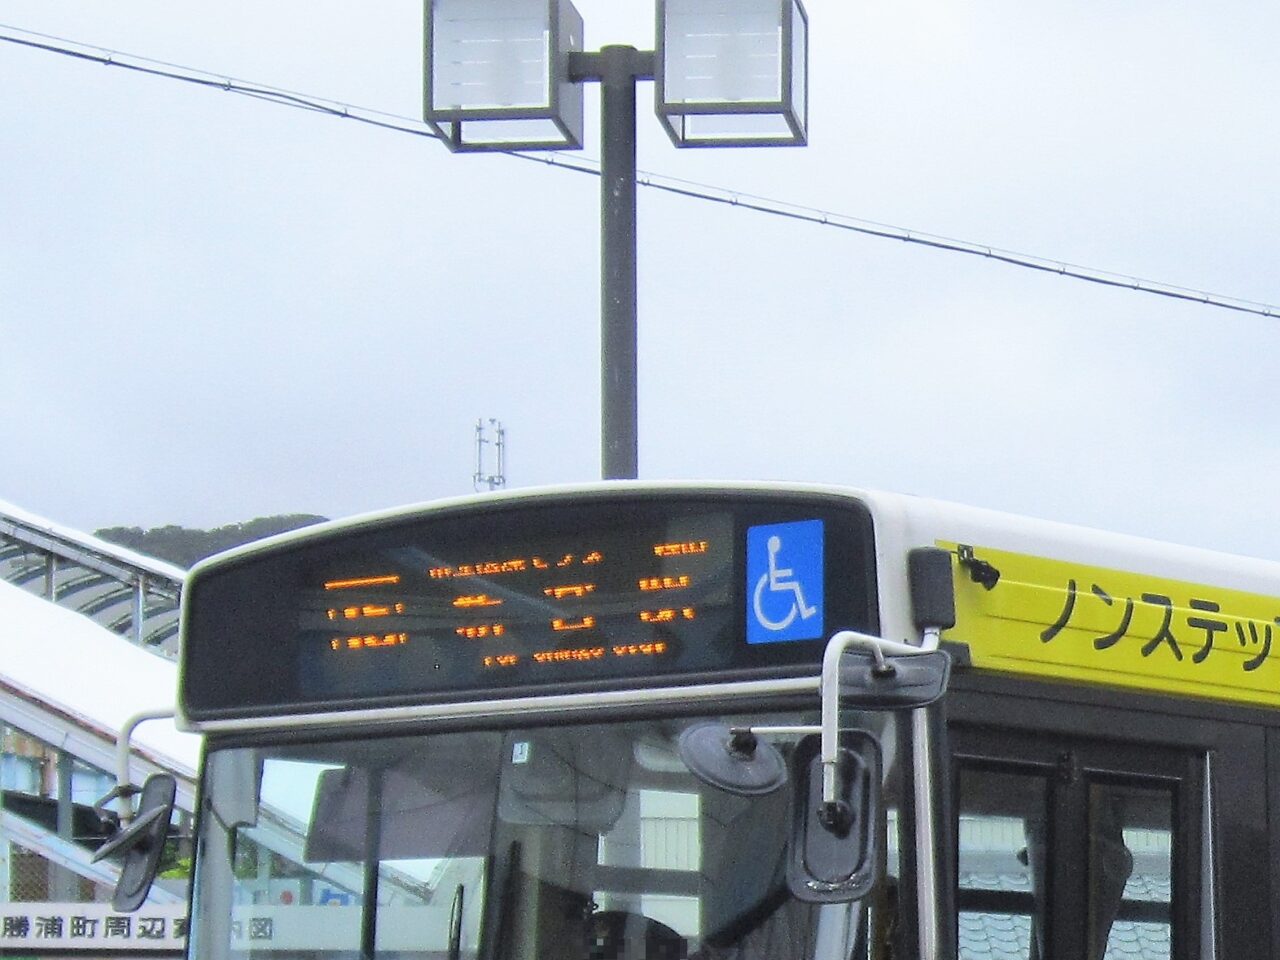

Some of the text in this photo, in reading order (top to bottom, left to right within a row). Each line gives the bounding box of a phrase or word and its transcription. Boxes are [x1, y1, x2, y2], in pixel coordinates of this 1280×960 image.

[3, 915, 274, 940] 勝浦町周辺図
